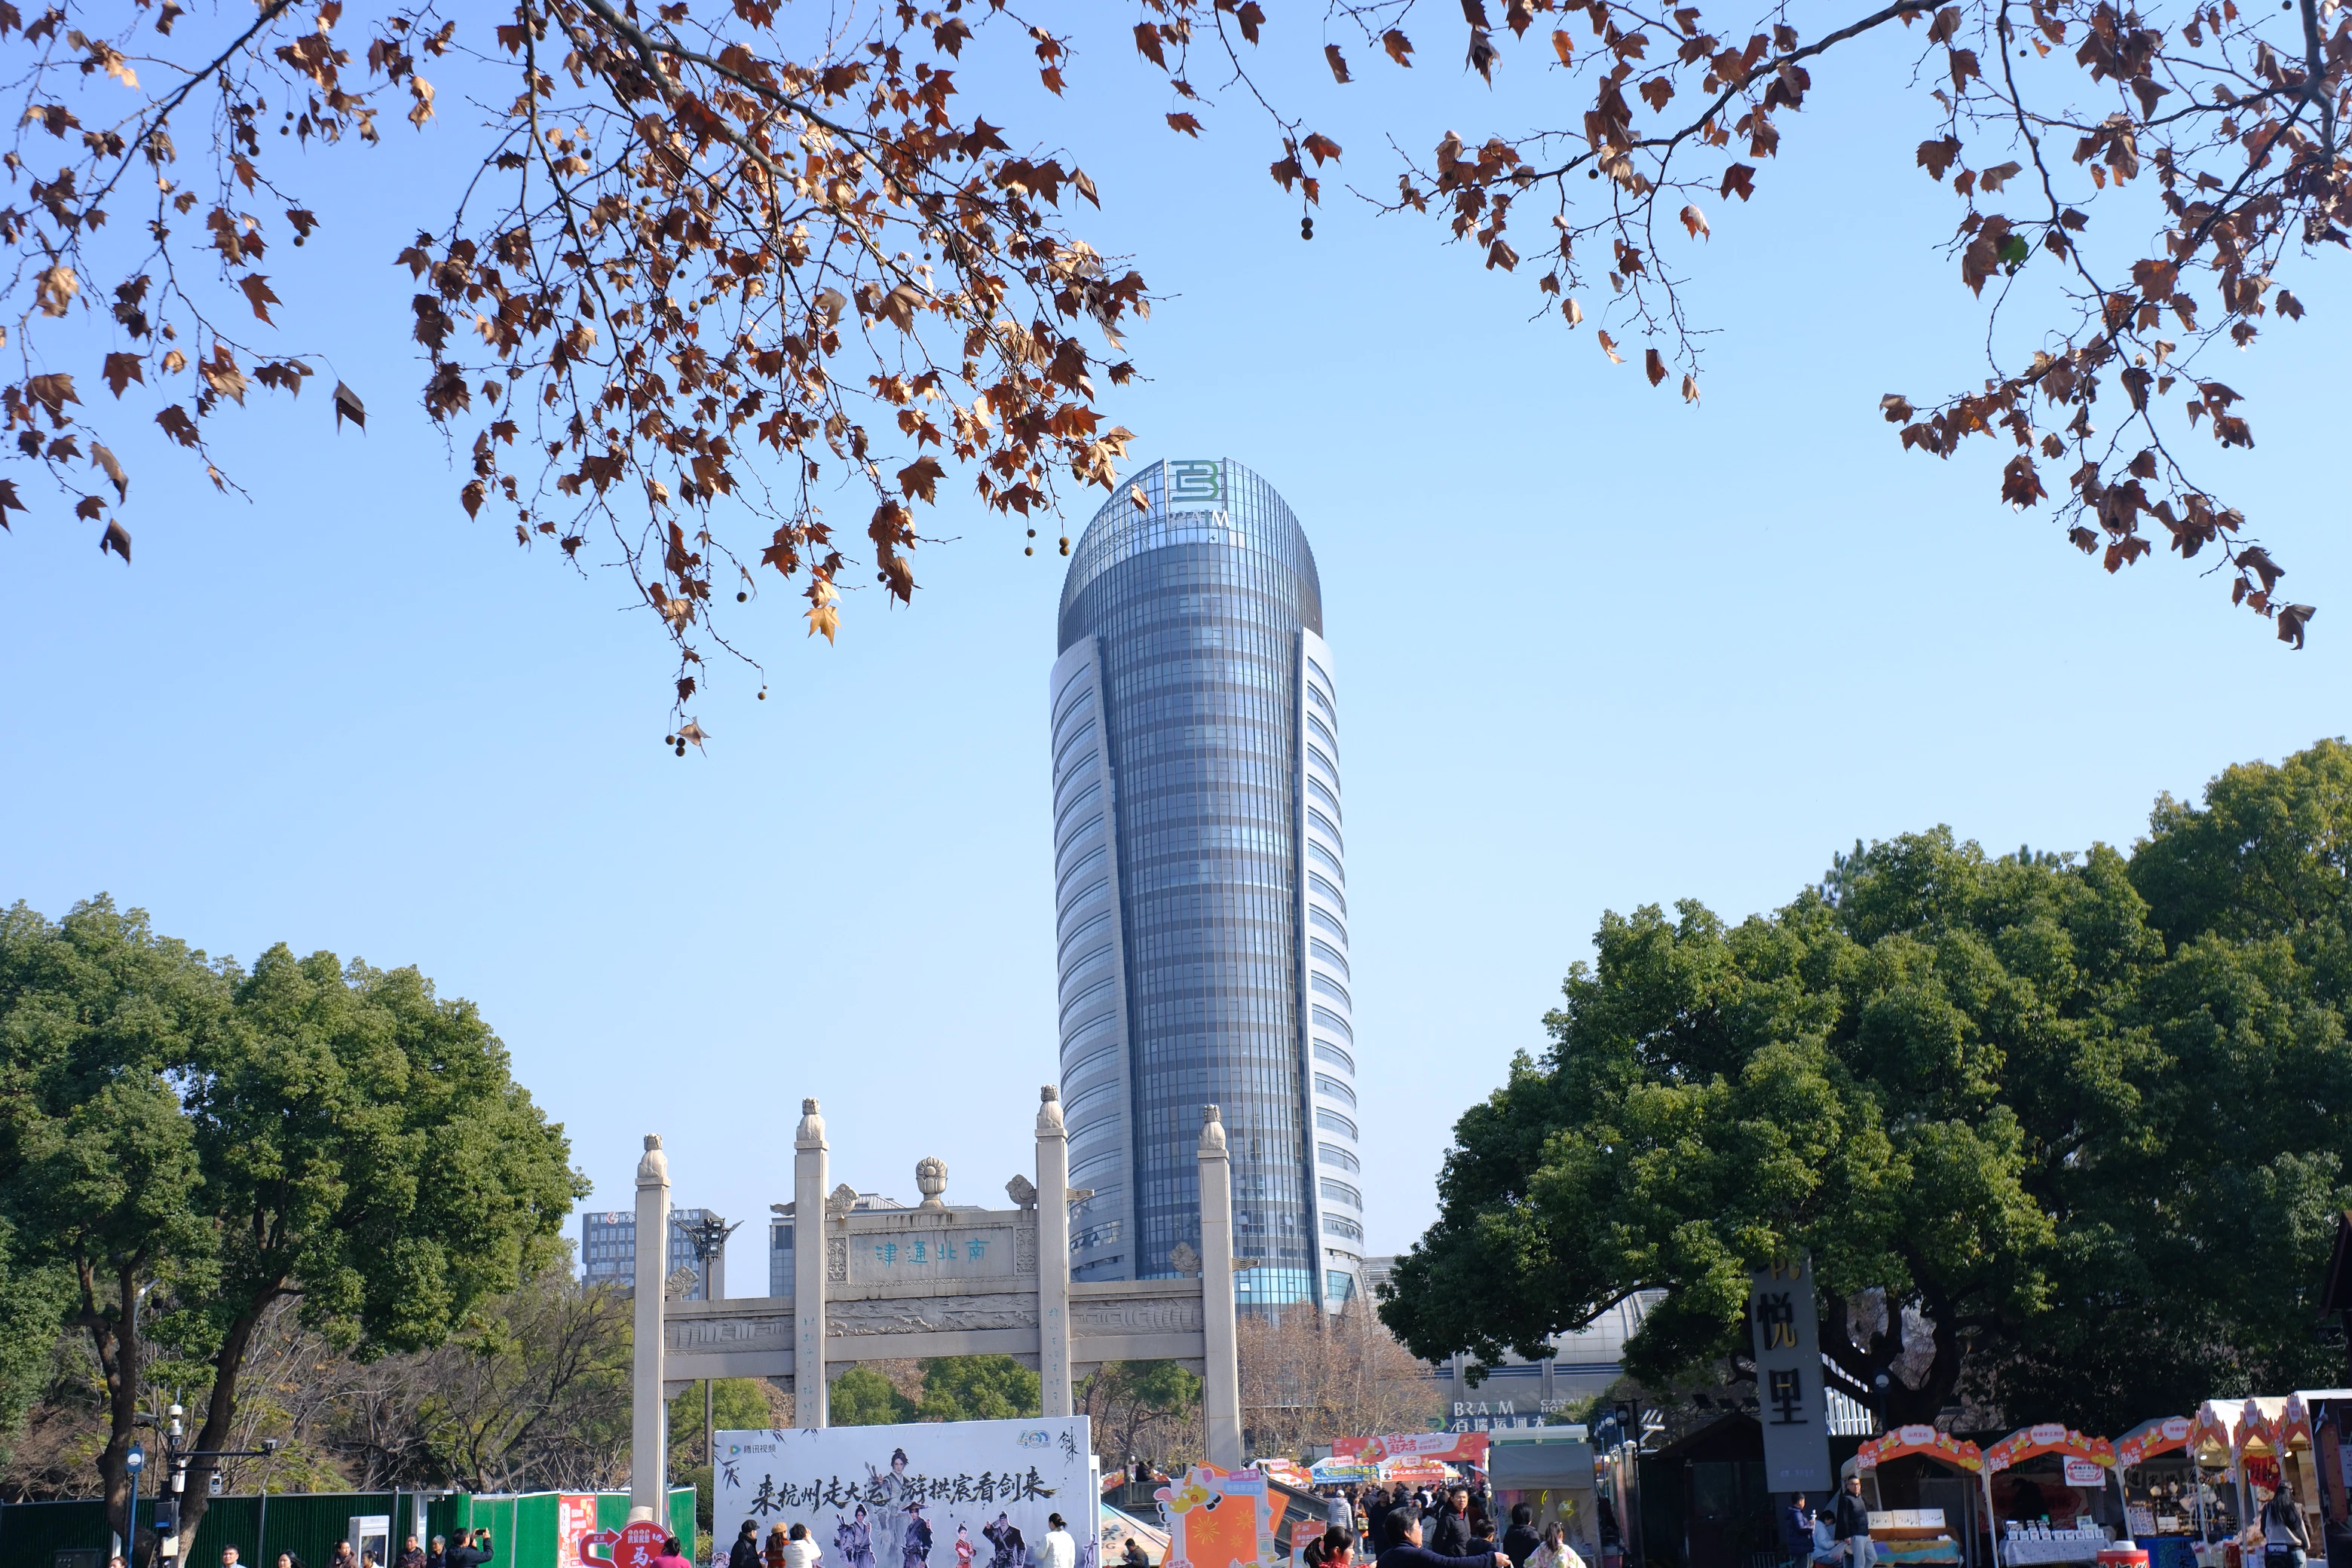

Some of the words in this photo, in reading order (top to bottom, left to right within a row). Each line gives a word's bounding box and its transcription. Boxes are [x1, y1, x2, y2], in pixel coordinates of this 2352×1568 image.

[743, 1444, 776, 1454] 腾讯视频
[744, 1473, 892, 1517] 来杭州走大运
[899, 1465, 1059, 1506] 游拱宸看剑来
